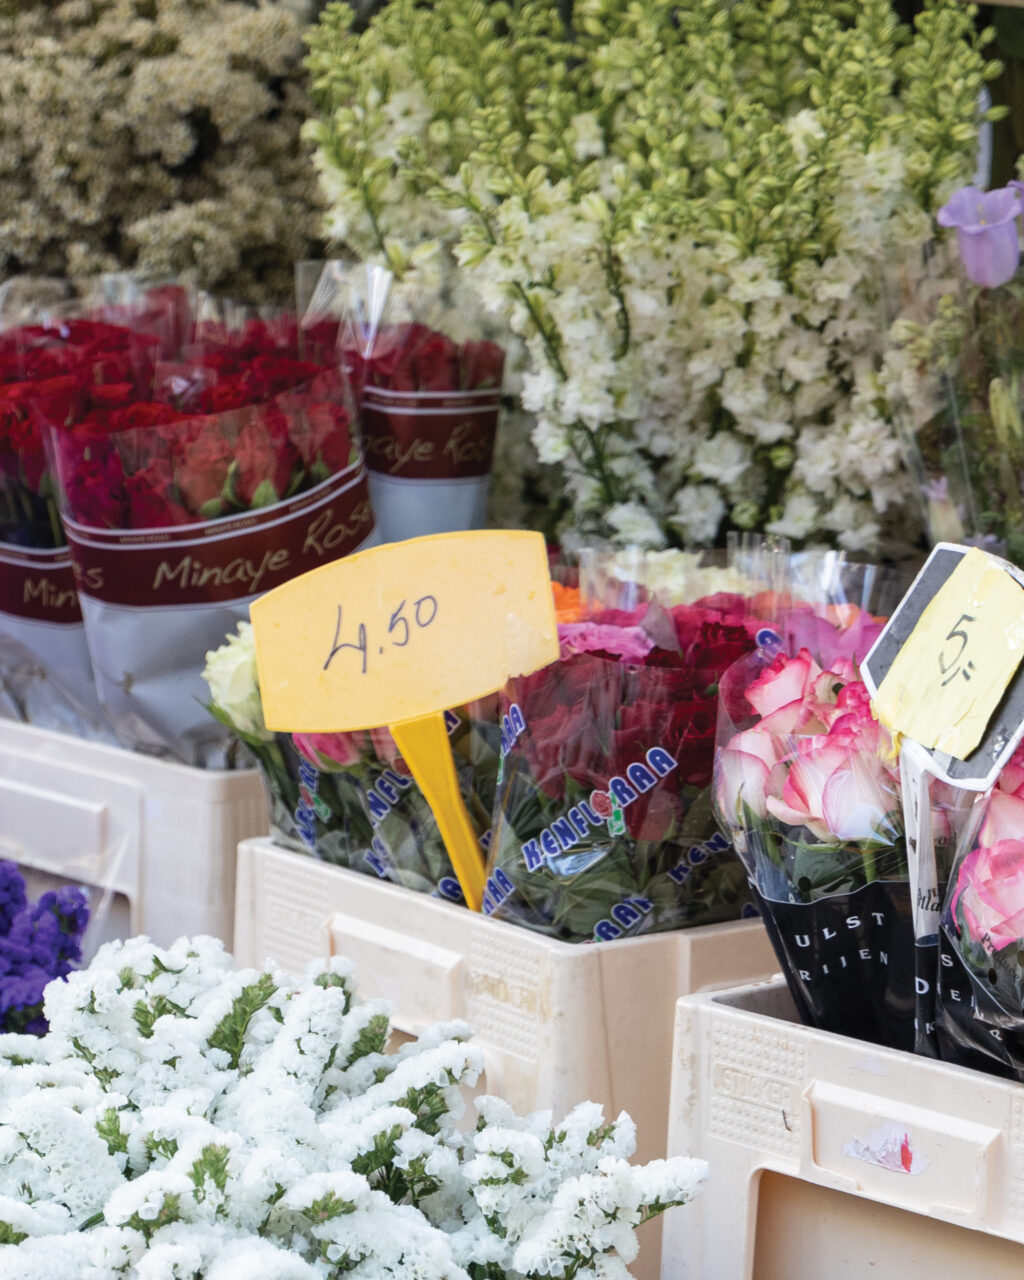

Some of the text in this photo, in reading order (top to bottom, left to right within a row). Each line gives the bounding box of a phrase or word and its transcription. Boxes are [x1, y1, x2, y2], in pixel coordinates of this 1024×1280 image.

[442, 421, 488, 465] Ro
[152, 555, 291, 593] Minaye
[323, 595, 437, 674] 4.50
